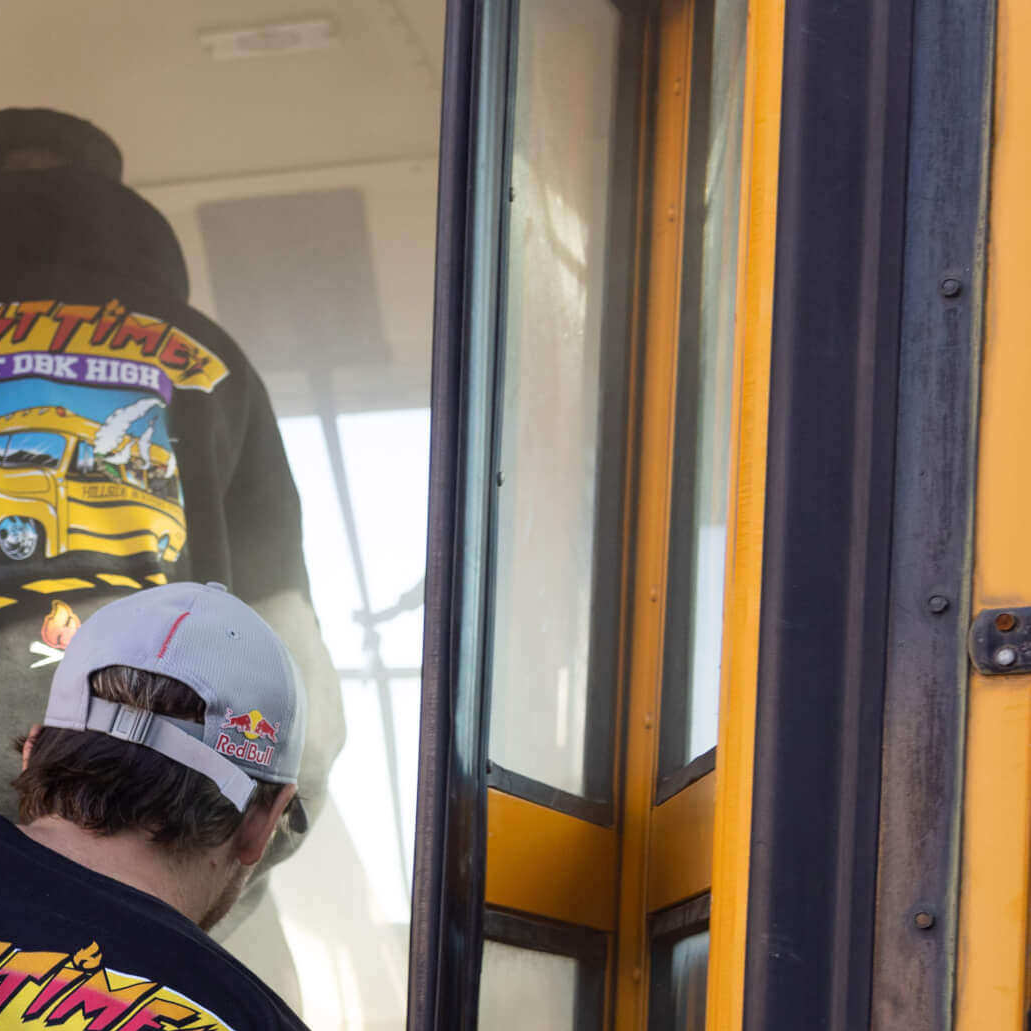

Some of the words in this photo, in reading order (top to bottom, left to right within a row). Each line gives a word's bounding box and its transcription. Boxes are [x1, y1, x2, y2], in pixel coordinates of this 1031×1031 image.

[12, 354, 78, 380] DBK
[85, 358, 161, 390] HIGH
[215, 733, 249, 759] Red
[245, 742, 274, 766] Bull
